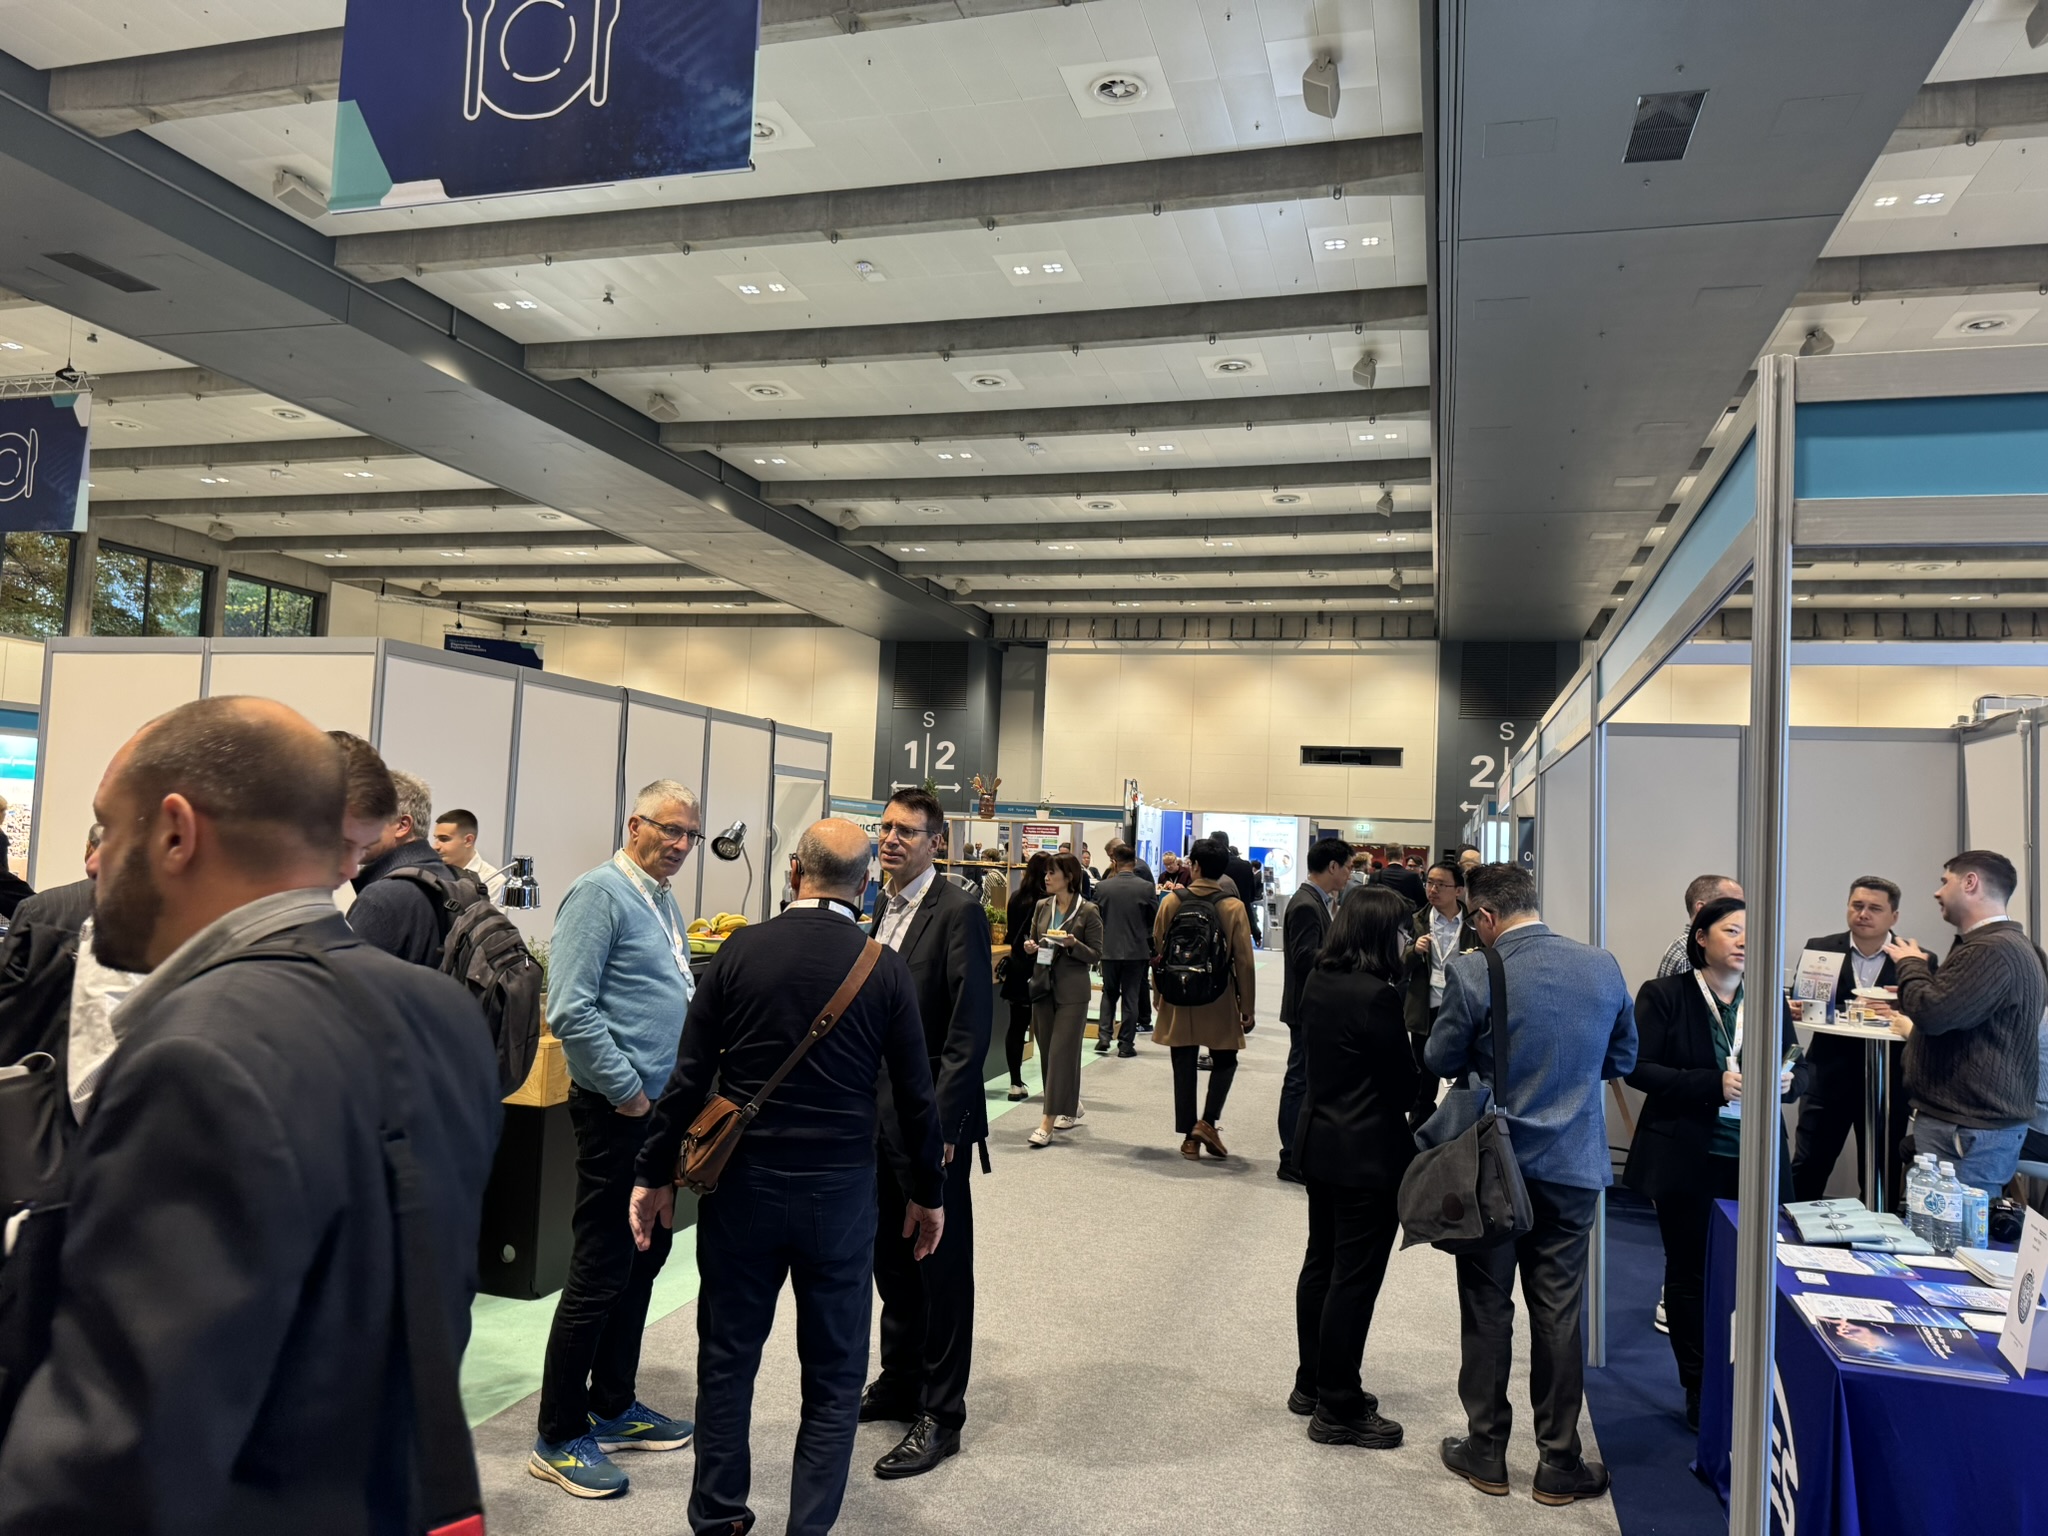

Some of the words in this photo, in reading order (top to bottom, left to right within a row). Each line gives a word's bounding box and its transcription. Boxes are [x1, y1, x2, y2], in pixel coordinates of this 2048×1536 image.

[923, 711, 935, 728] S
[1499, 721, 1515, 741] S
[904, 740, 918, 769] 1
[935, 740, 956, 770] 2
[1469, 754, 1495, 788] 2
